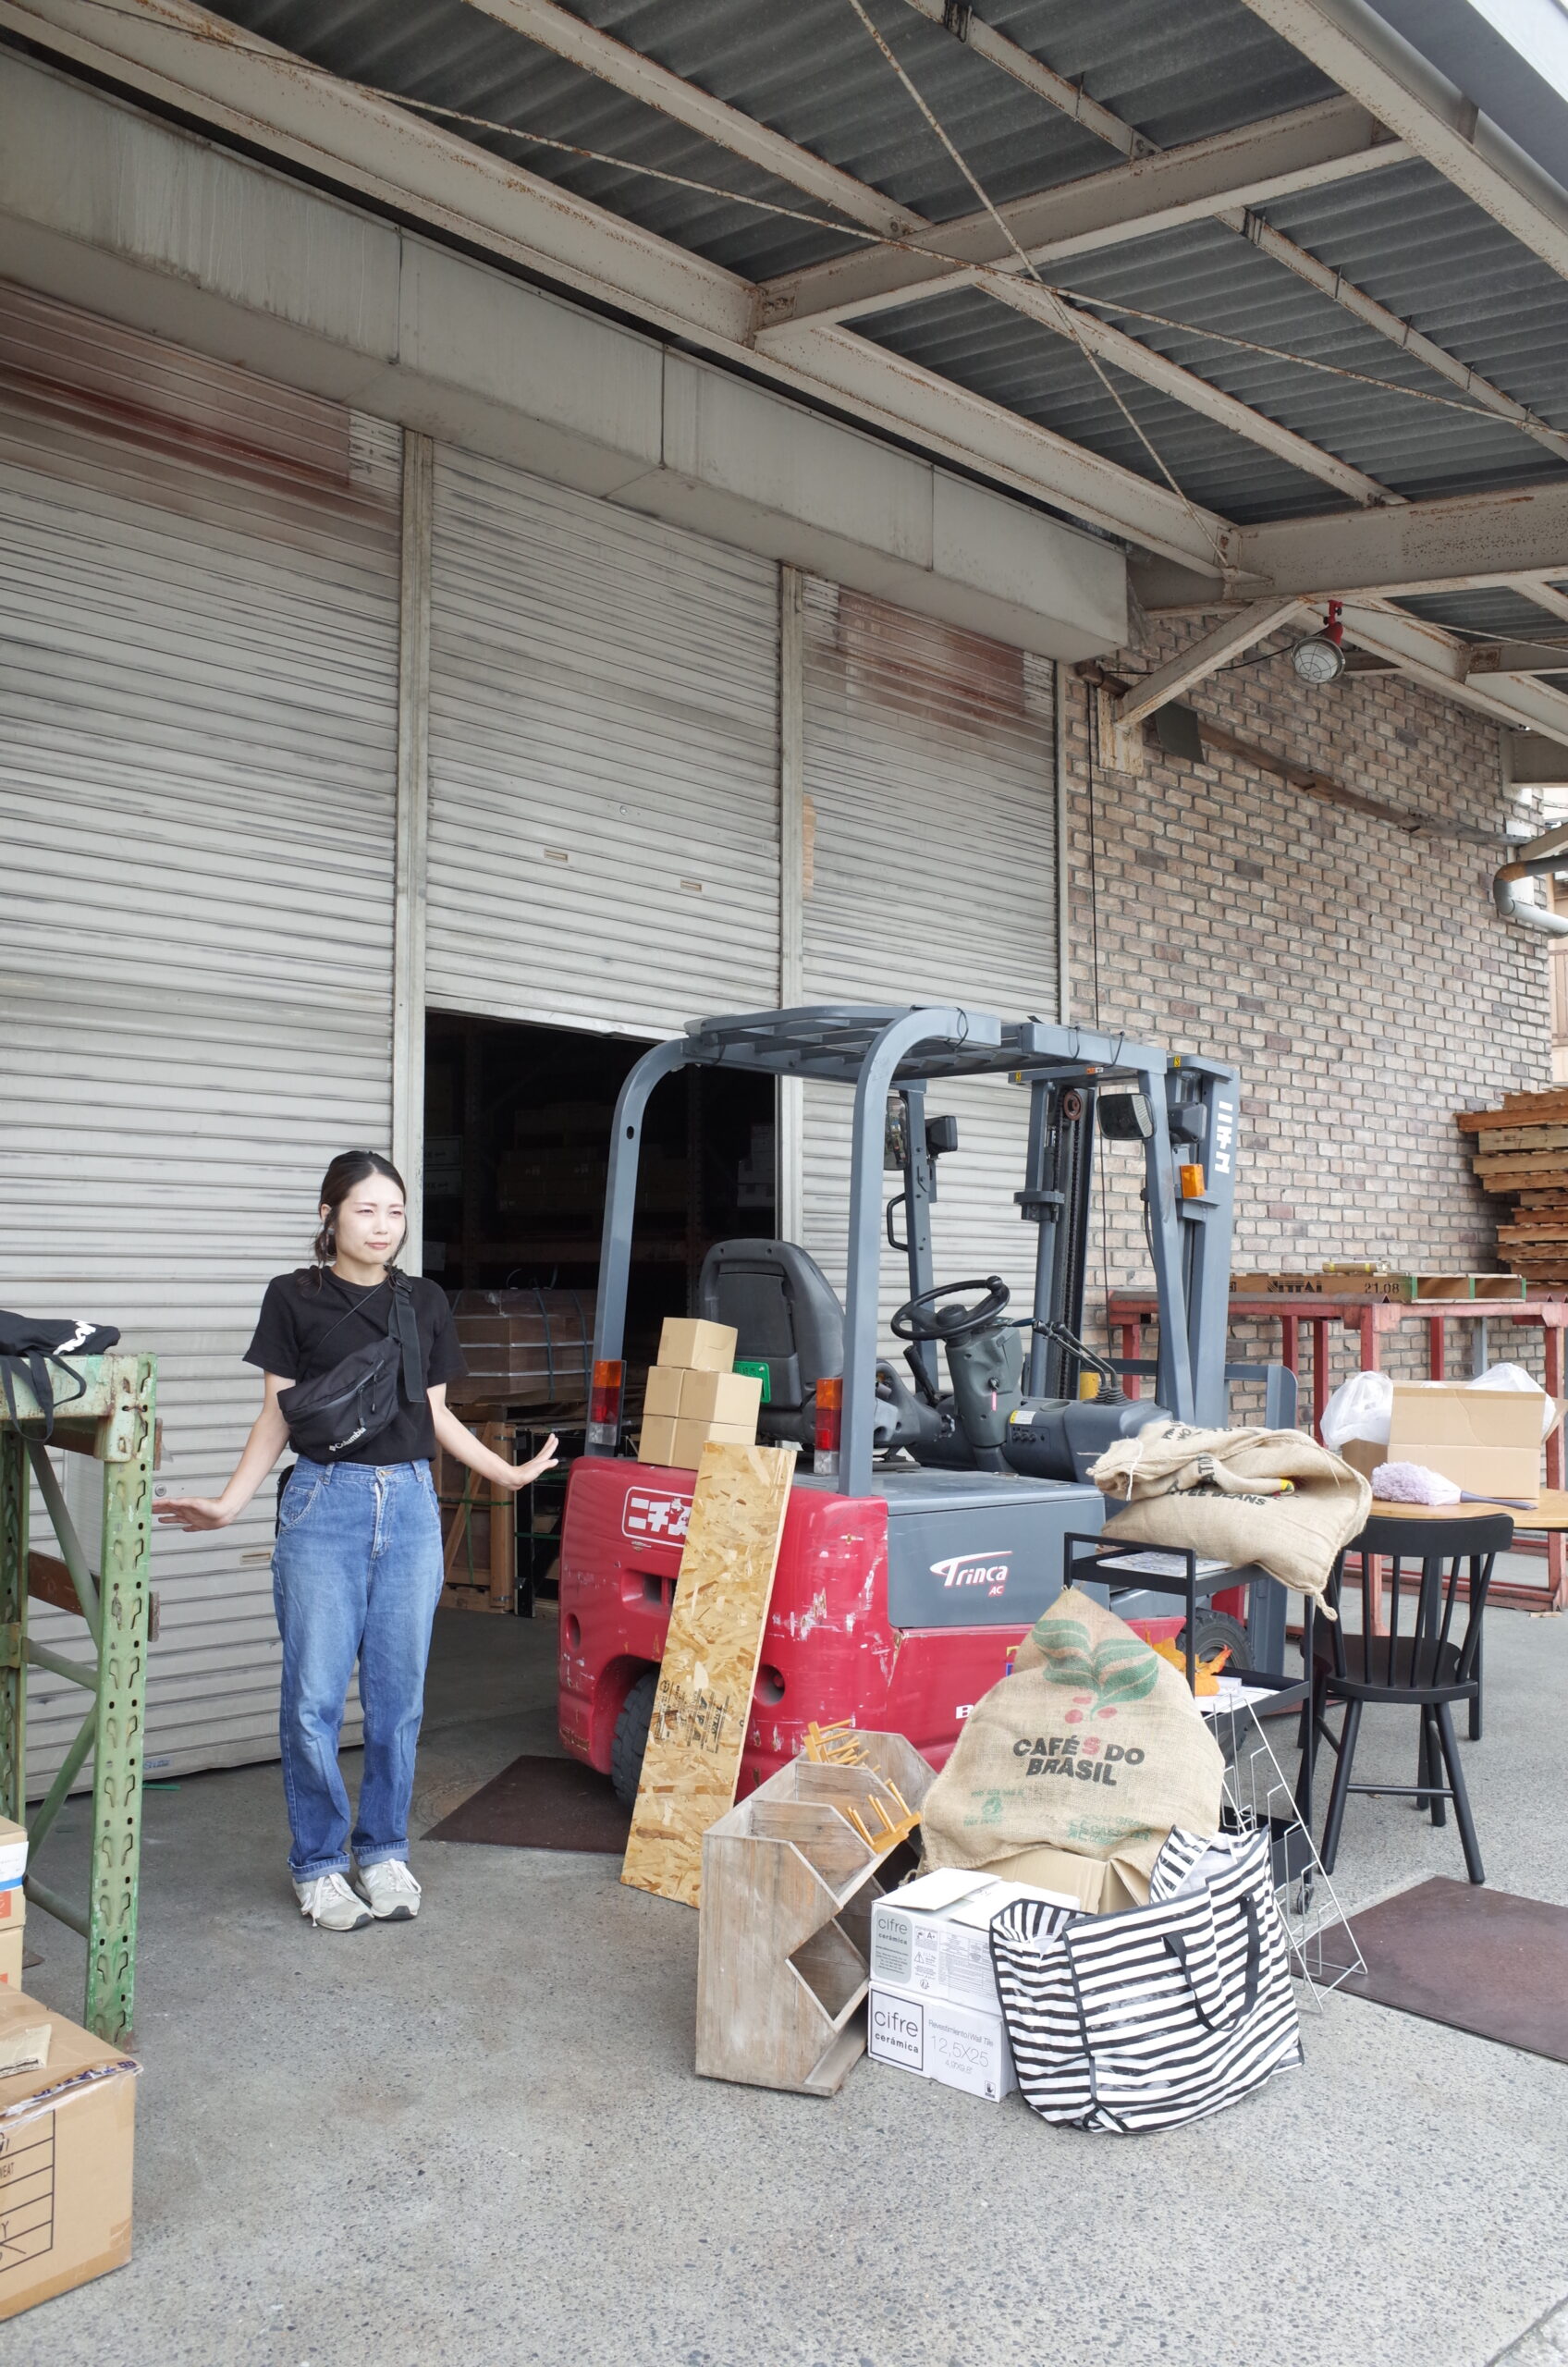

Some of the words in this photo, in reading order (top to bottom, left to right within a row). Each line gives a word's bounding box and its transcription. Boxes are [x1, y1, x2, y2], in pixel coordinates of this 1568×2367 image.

[1214, 1100, 1233, 1174] ニチユ
[1364, 1282, 1400, 1294] 21.08
[335, 1427, 367, 1449] Columbia
[929, 1551, 1013, 1588] Trinca
[988, 1585, 1005, 1597] AC
[1104, 1744, 1145, 1765] DO
[1026, 1757, 1117, 1785] BRASIL
[877, 1919, 908, 1935] cifre
[874, 2010, 919, 2038] cifre
[875, 2032, 919, 2054] cerámica
